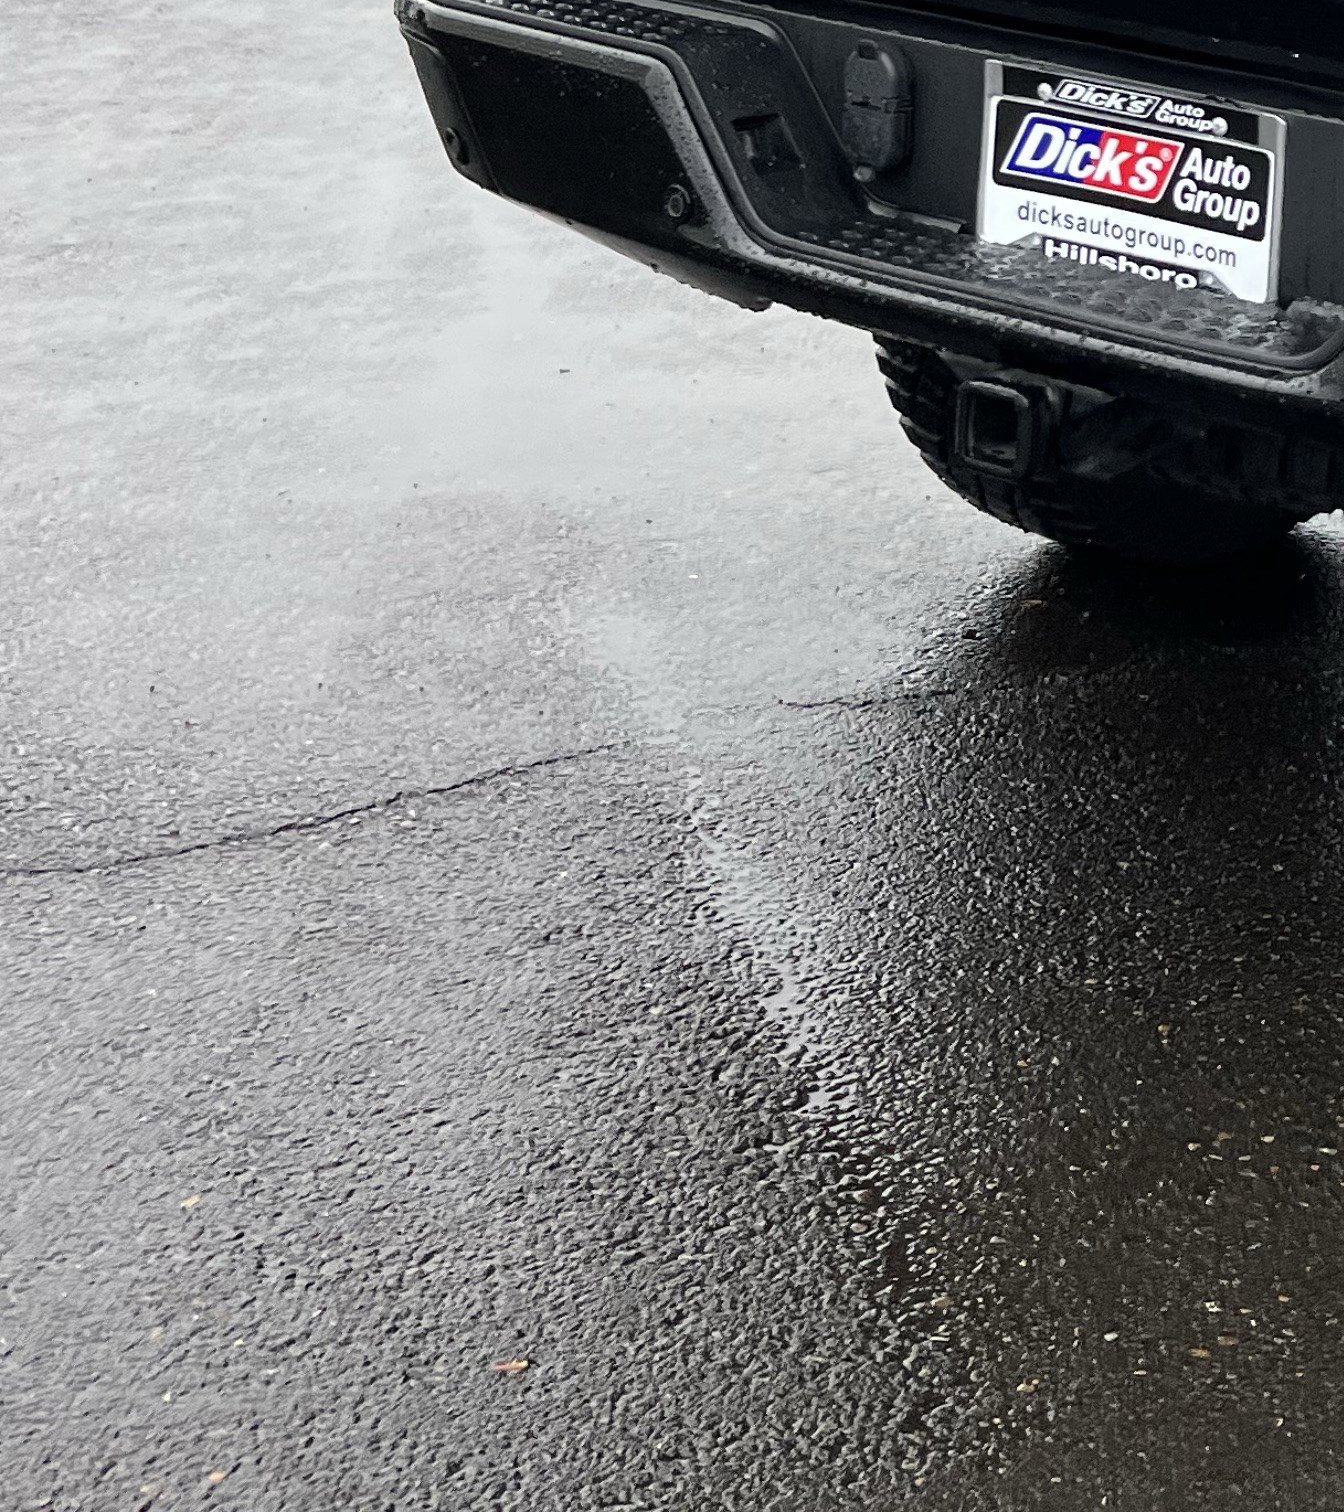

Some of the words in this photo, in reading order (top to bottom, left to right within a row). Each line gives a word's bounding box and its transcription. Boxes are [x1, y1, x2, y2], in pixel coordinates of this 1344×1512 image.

[1058, 83, 1152, 115] Dick's
[1160, 99, 1206, 119] Auto
[1154, 109, 1214, 132] Group
[1015, 122, 1164, 193] Dick's
[1180, 148, 1251, 191] Auto
[1173, 179, 1260, 230] Group
[1017, 200, 1237, 268] dicksautogroup.com
[1044, 238, 1198, 289] Hillsboro
